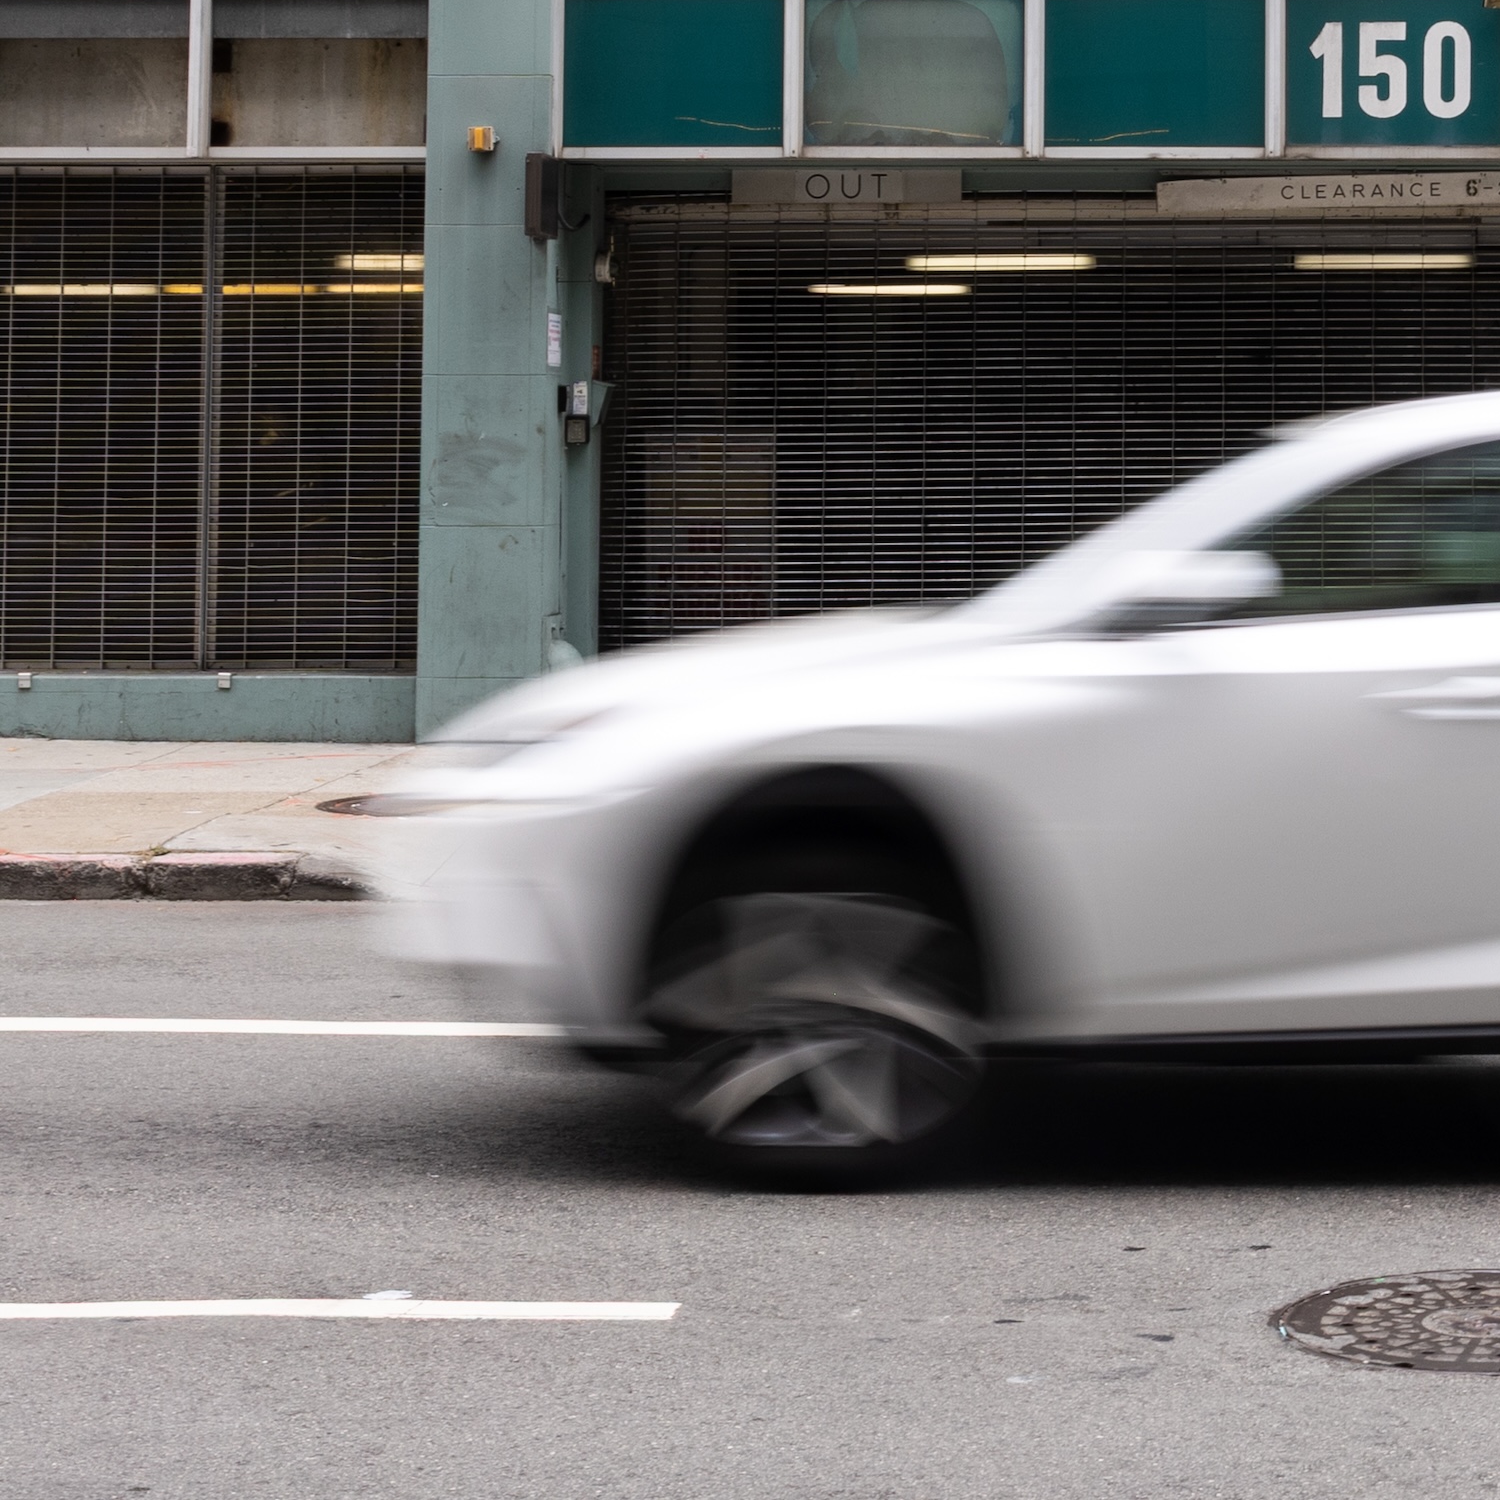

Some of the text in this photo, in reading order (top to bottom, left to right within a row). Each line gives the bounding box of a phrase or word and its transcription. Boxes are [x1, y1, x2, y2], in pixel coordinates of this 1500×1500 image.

[1308, 20, 1472, 119] 150
[805, 173, 888, 199] OUT
[1280, 182, 1442, 200] CLEARANCE
